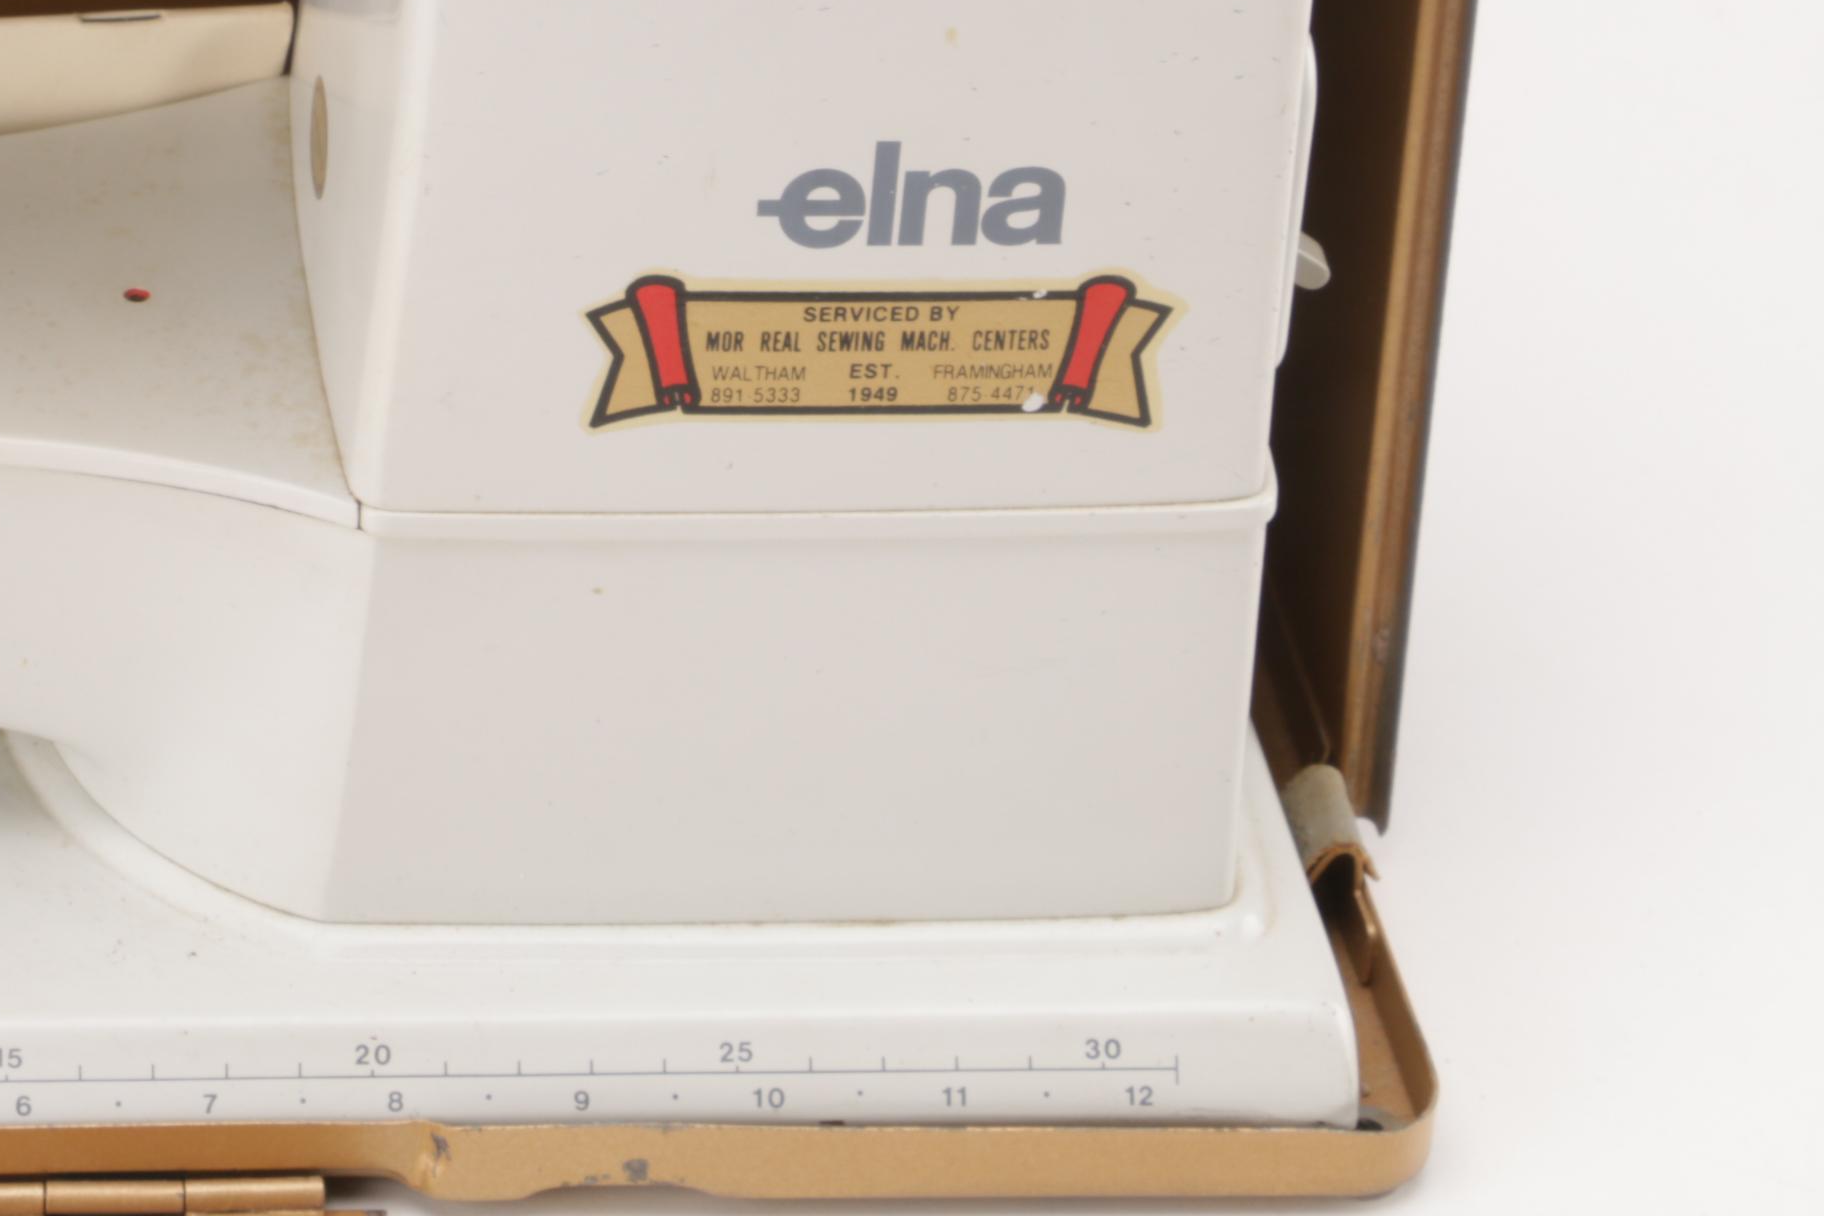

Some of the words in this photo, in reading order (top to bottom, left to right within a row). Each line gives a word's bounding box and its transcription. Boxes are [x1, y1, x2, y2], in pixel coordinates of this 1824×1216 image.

[756, 140, 1066, 250] elna
[803, 305, 920, 323] SERVICED
[930, 306, 958, 321] BY
[705, 331, 745, 352] MOR
[760, 330, 801, 353] REAL
[816, 330, 885, 353] SEWING
[901, 331, 955, 352] MACH.
[972, 328, 1050, 352] CENTERS
[711, 364, 807, 382] WALTHAM
[849, 364, 900, 379] EST.
[933, 362, 1053, 380] FRAMINGHAM
[849, 386, 898, 402] 1949
[356, 1044, 391, 1065] 20
[720, 1042, 753, 1063] 25
[1086, 1039, 1121, 1059] 30
[16, 1096, 32, 1116] 6
[204, 1094, 217, 1115] 7
[388, 1091, 403, 1112] 8
[574, 1091, 590, 1112] 9
[754, 1088, 785, 1112] 10
[943, 1087, 966, 1107] 11
[1126, 1086, 1154, 1107] 12
